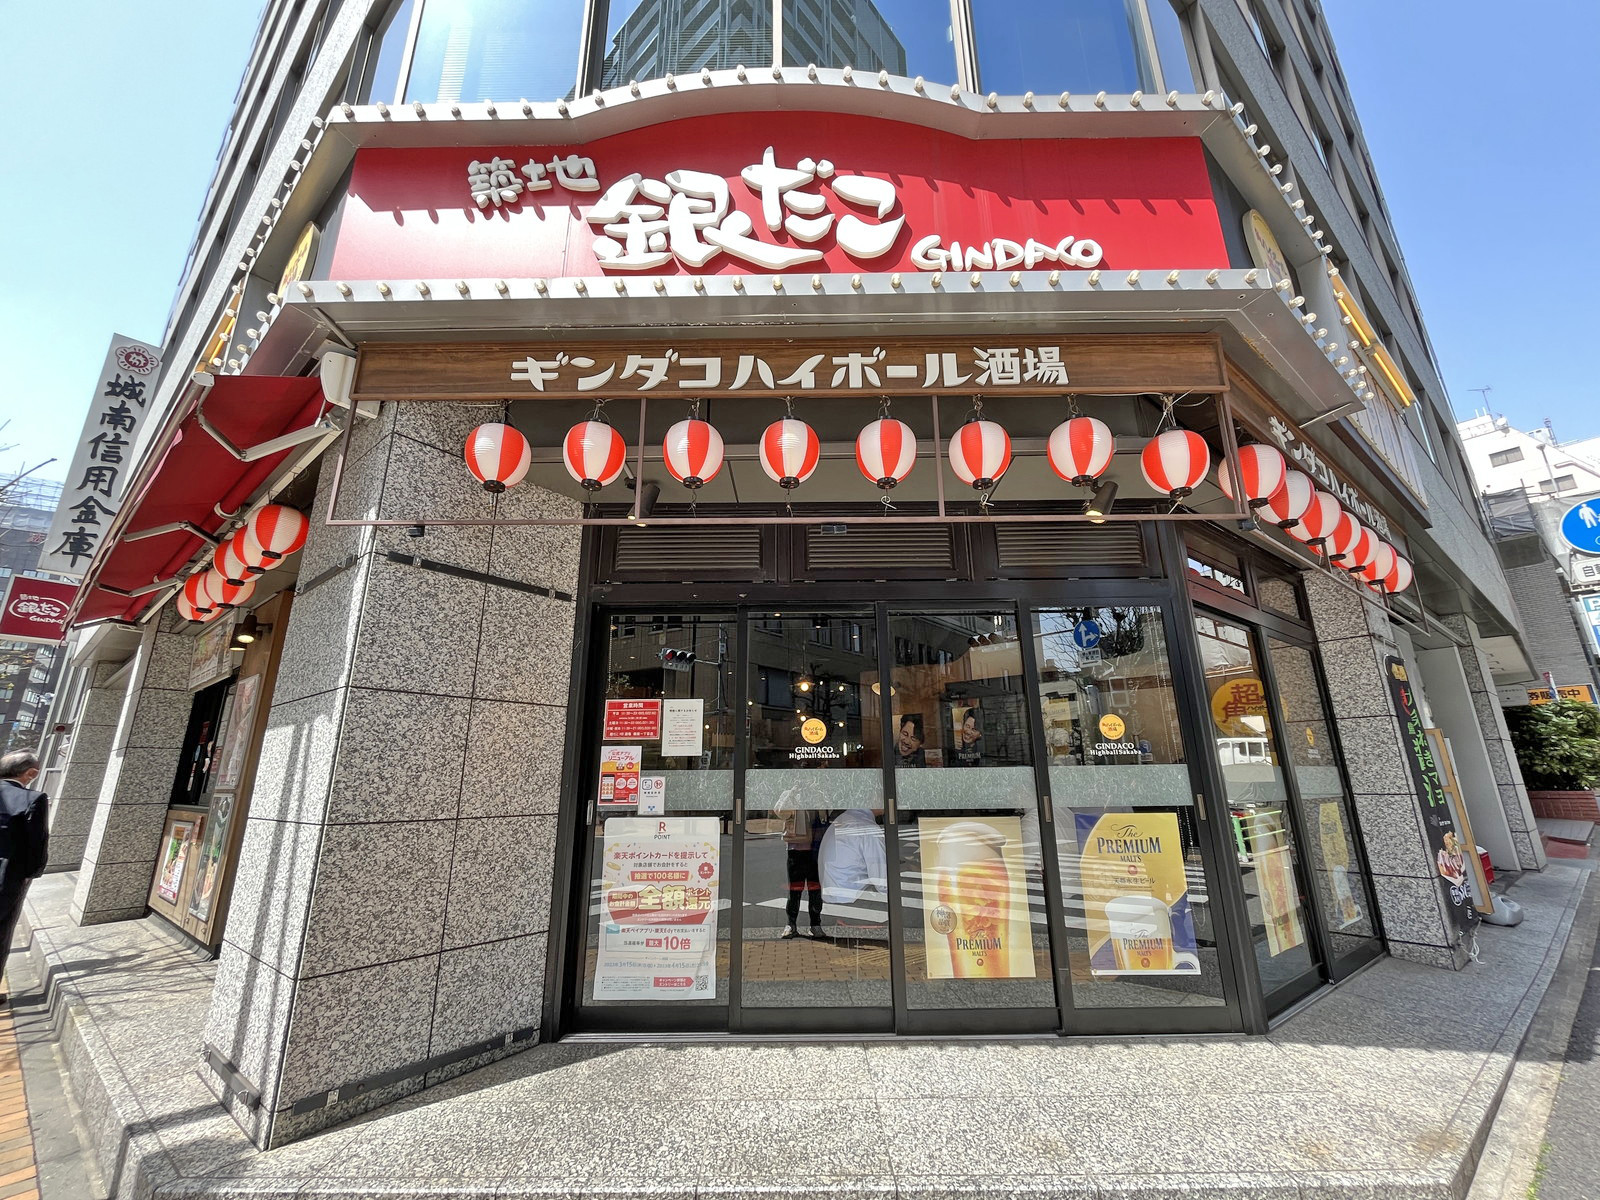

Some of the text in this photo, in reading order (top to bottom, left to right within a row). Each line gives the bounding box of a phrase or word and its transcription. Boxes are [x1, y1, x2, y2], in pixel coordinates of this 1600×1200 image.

[466, 154, 601, 208] 築地
[586, 146, 906, 271] 銀だこ
[910, 234, 1104, 271] GINDACO
[510, 345, 1071, 392] ギンダコハイボール酒場
[49, 373, 147, 568] 城南信用金庫
[17, 601, 62, 618] 銀だこ
[795, 746, 834, 754] GINDACO
[1089, 749, 1119, 757] Highball
[1094, 742, 1135, 750] GINDACO
[788, 753, 817, 761] Highball
[659, 821, 667, 832] R
[1111, 823, 1144, 838] The
[1096, 836, 1163, 854] PREMIUM
[613, 851, 708, 860] 楽天ポイントカードを提示して
[1119, 853, 1142, 863] MALT'S
[637, 884, 687, 911] 全額
[686, 886, 712, 896] ポイント
[685, 896, 711, 910] 還元
[663, 935, 692, 950] 10倍
[956, 937, 1002, 950] PREMIUM
[1122, 937, 1164, 950] PREMIUM
